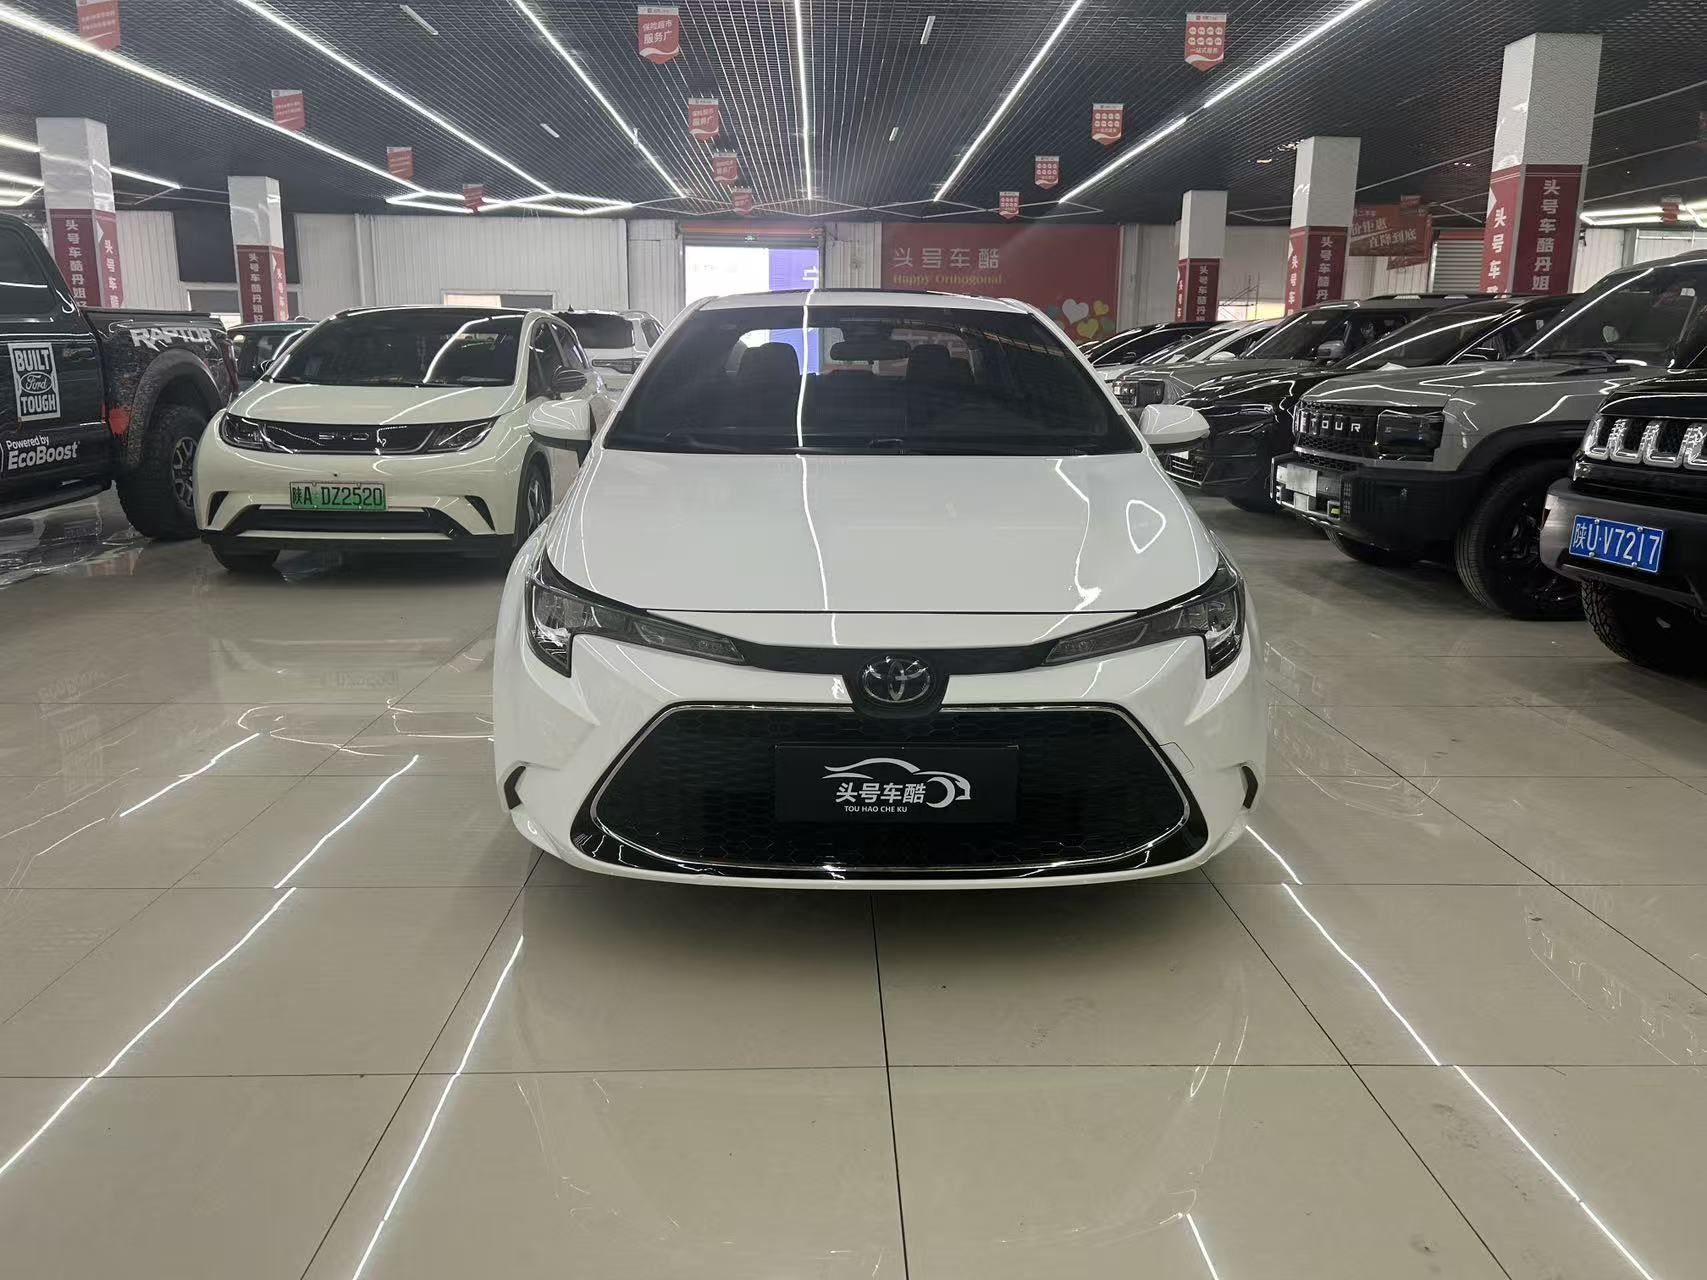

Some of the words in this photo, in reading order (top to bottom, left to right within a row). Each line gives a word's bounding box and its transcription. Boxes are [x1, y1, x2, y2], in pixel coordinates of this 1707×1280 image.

[1532, 179, 1560, 290] 头号车酷丹姐
[894, 248, 999, 269] 头号车酷
[130, 327, 220, 352] RAPTOR
[14, 349, 50, 371] BUILT
[25, 374, 48, 390] Ford
[21, 394, 56, 414] TOUGH
[6, 436, 40, 450] Powered
[39, 435, 49, 446] by
[8, 441, 78, 470] EcoBoost
[321, 486, 383, 506] DZ2520
[835, 782, 926, 803] 头号车酷
[844, 805, 860, 813] TOU
[862, 805, 879, 813] HAO
[880, 805, 896, 813] CHE
[897, 805, 908, 813] KU
